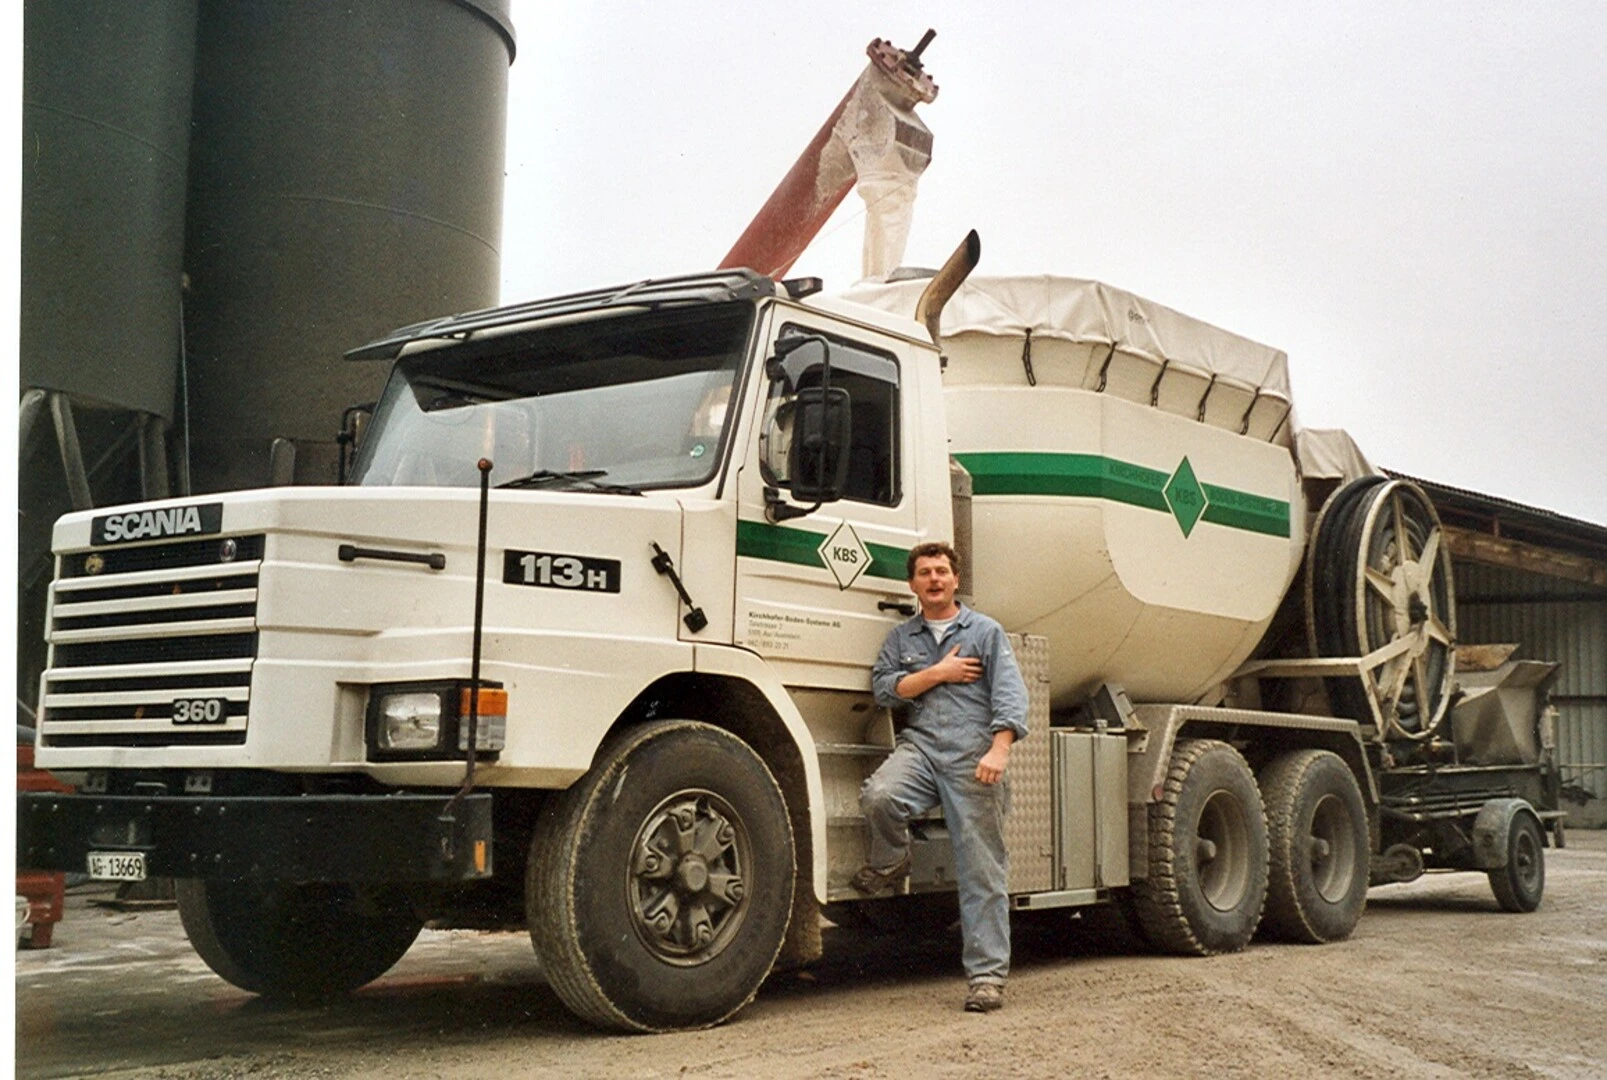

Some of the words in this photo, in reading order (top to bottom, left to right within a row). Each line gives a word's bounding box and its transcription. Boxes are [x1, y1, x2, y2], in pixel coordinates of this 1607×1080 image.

[1175, 487, 1197, 507] KBS
[103, 506, 202, 542] SCANIA
[833, 546, 858, 564] KBS
[173, 699, 221, 722] 360
